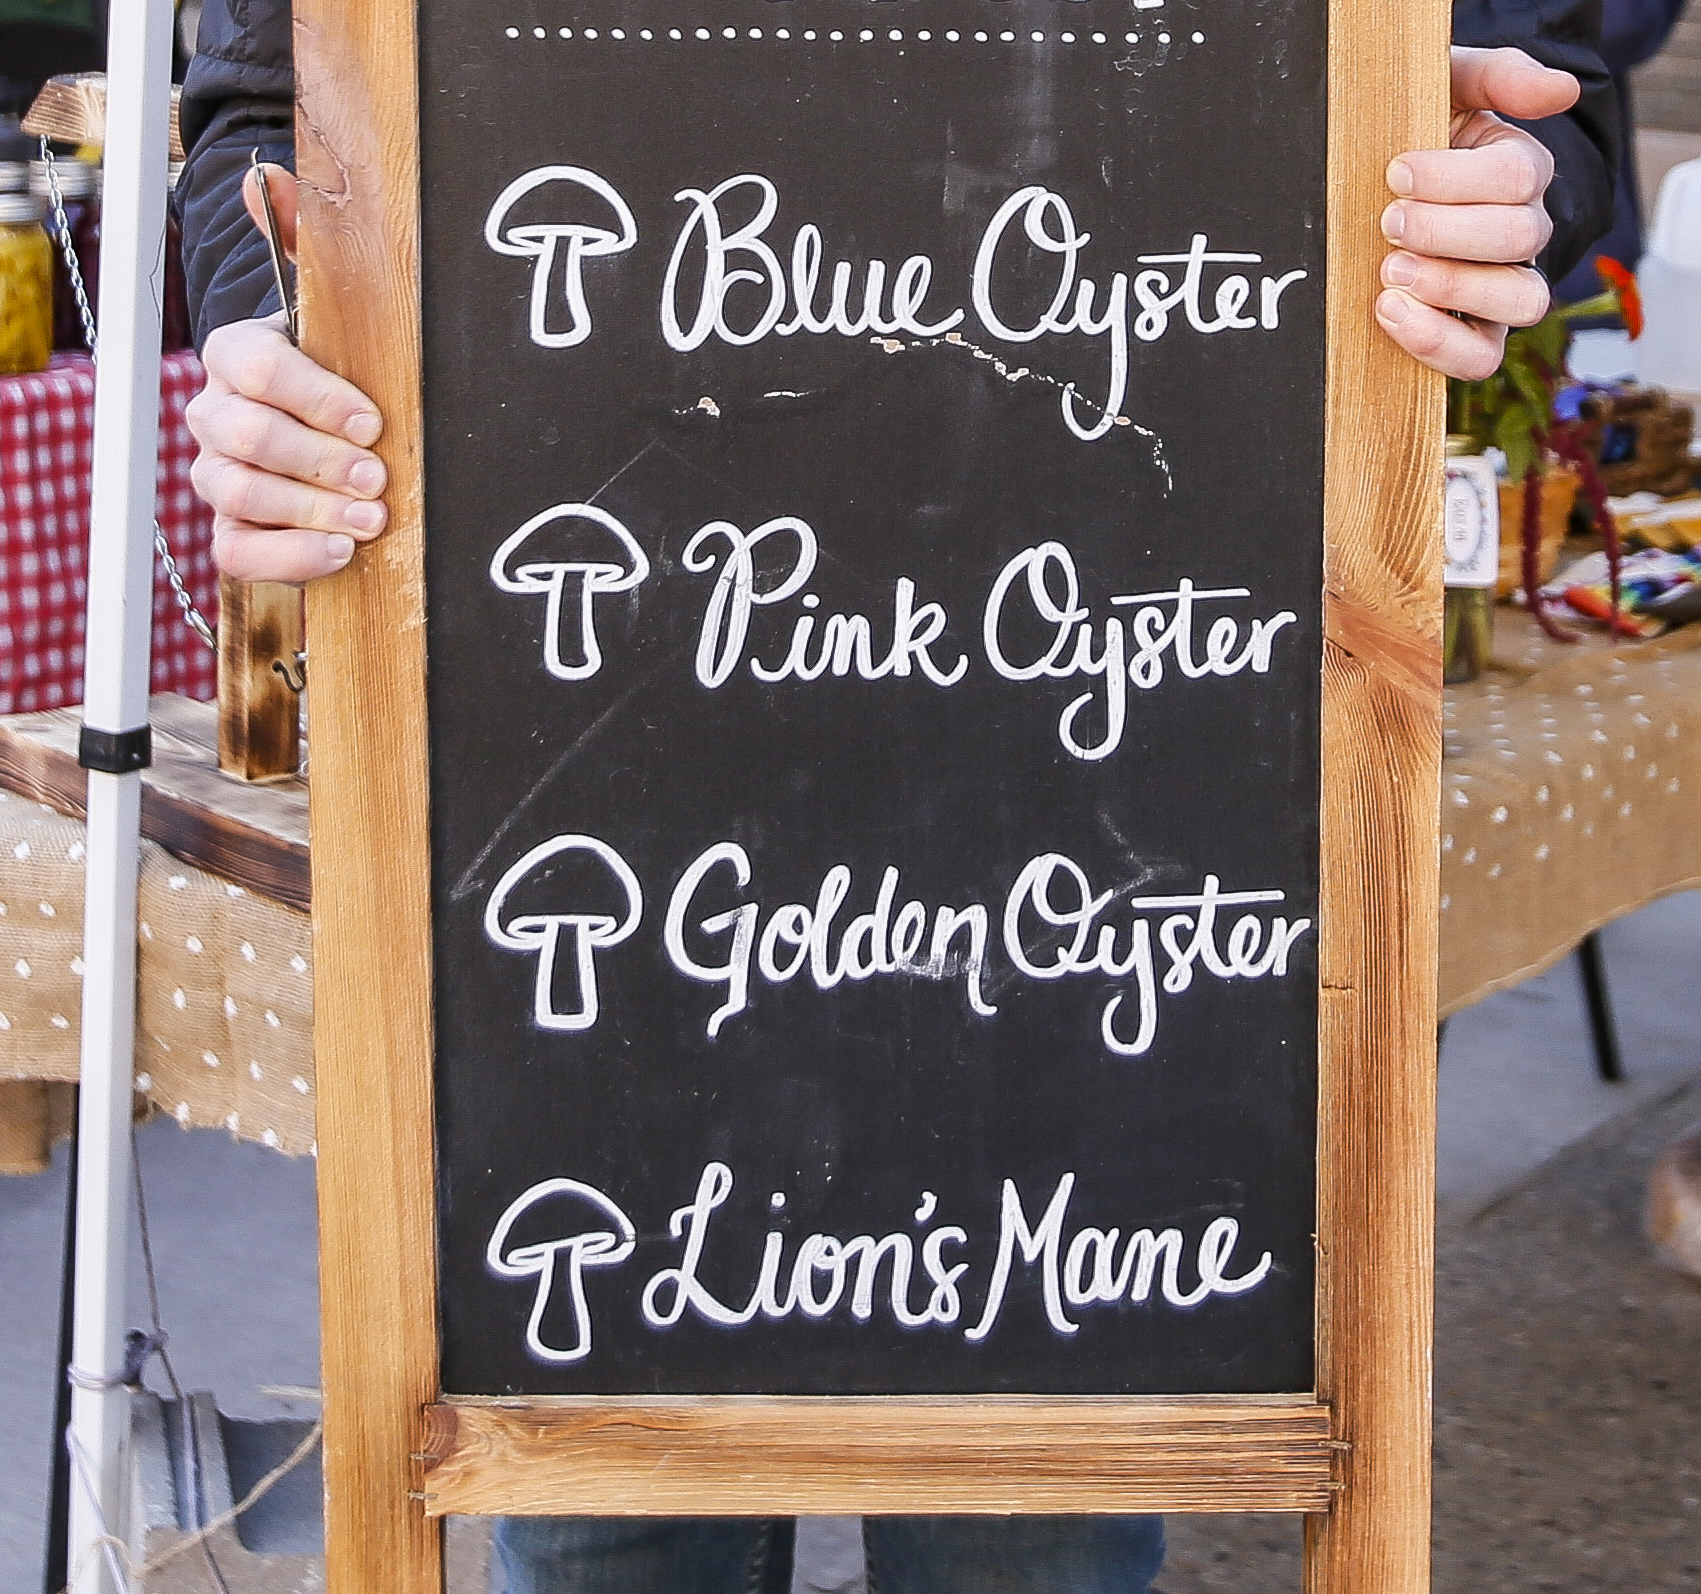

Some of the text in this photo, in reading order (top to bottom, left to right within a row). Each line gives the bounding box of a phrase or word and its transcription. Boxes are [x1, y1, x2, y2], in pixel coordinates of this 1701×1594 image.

[660, 172, 1309, 442] Blue Oyster
[681, 514, 1298, 763] Pink Oyster
[663, 840, 1313, 1058] Golden Oyster
[641, 1159, 1273, 1342] Lion's Mane
